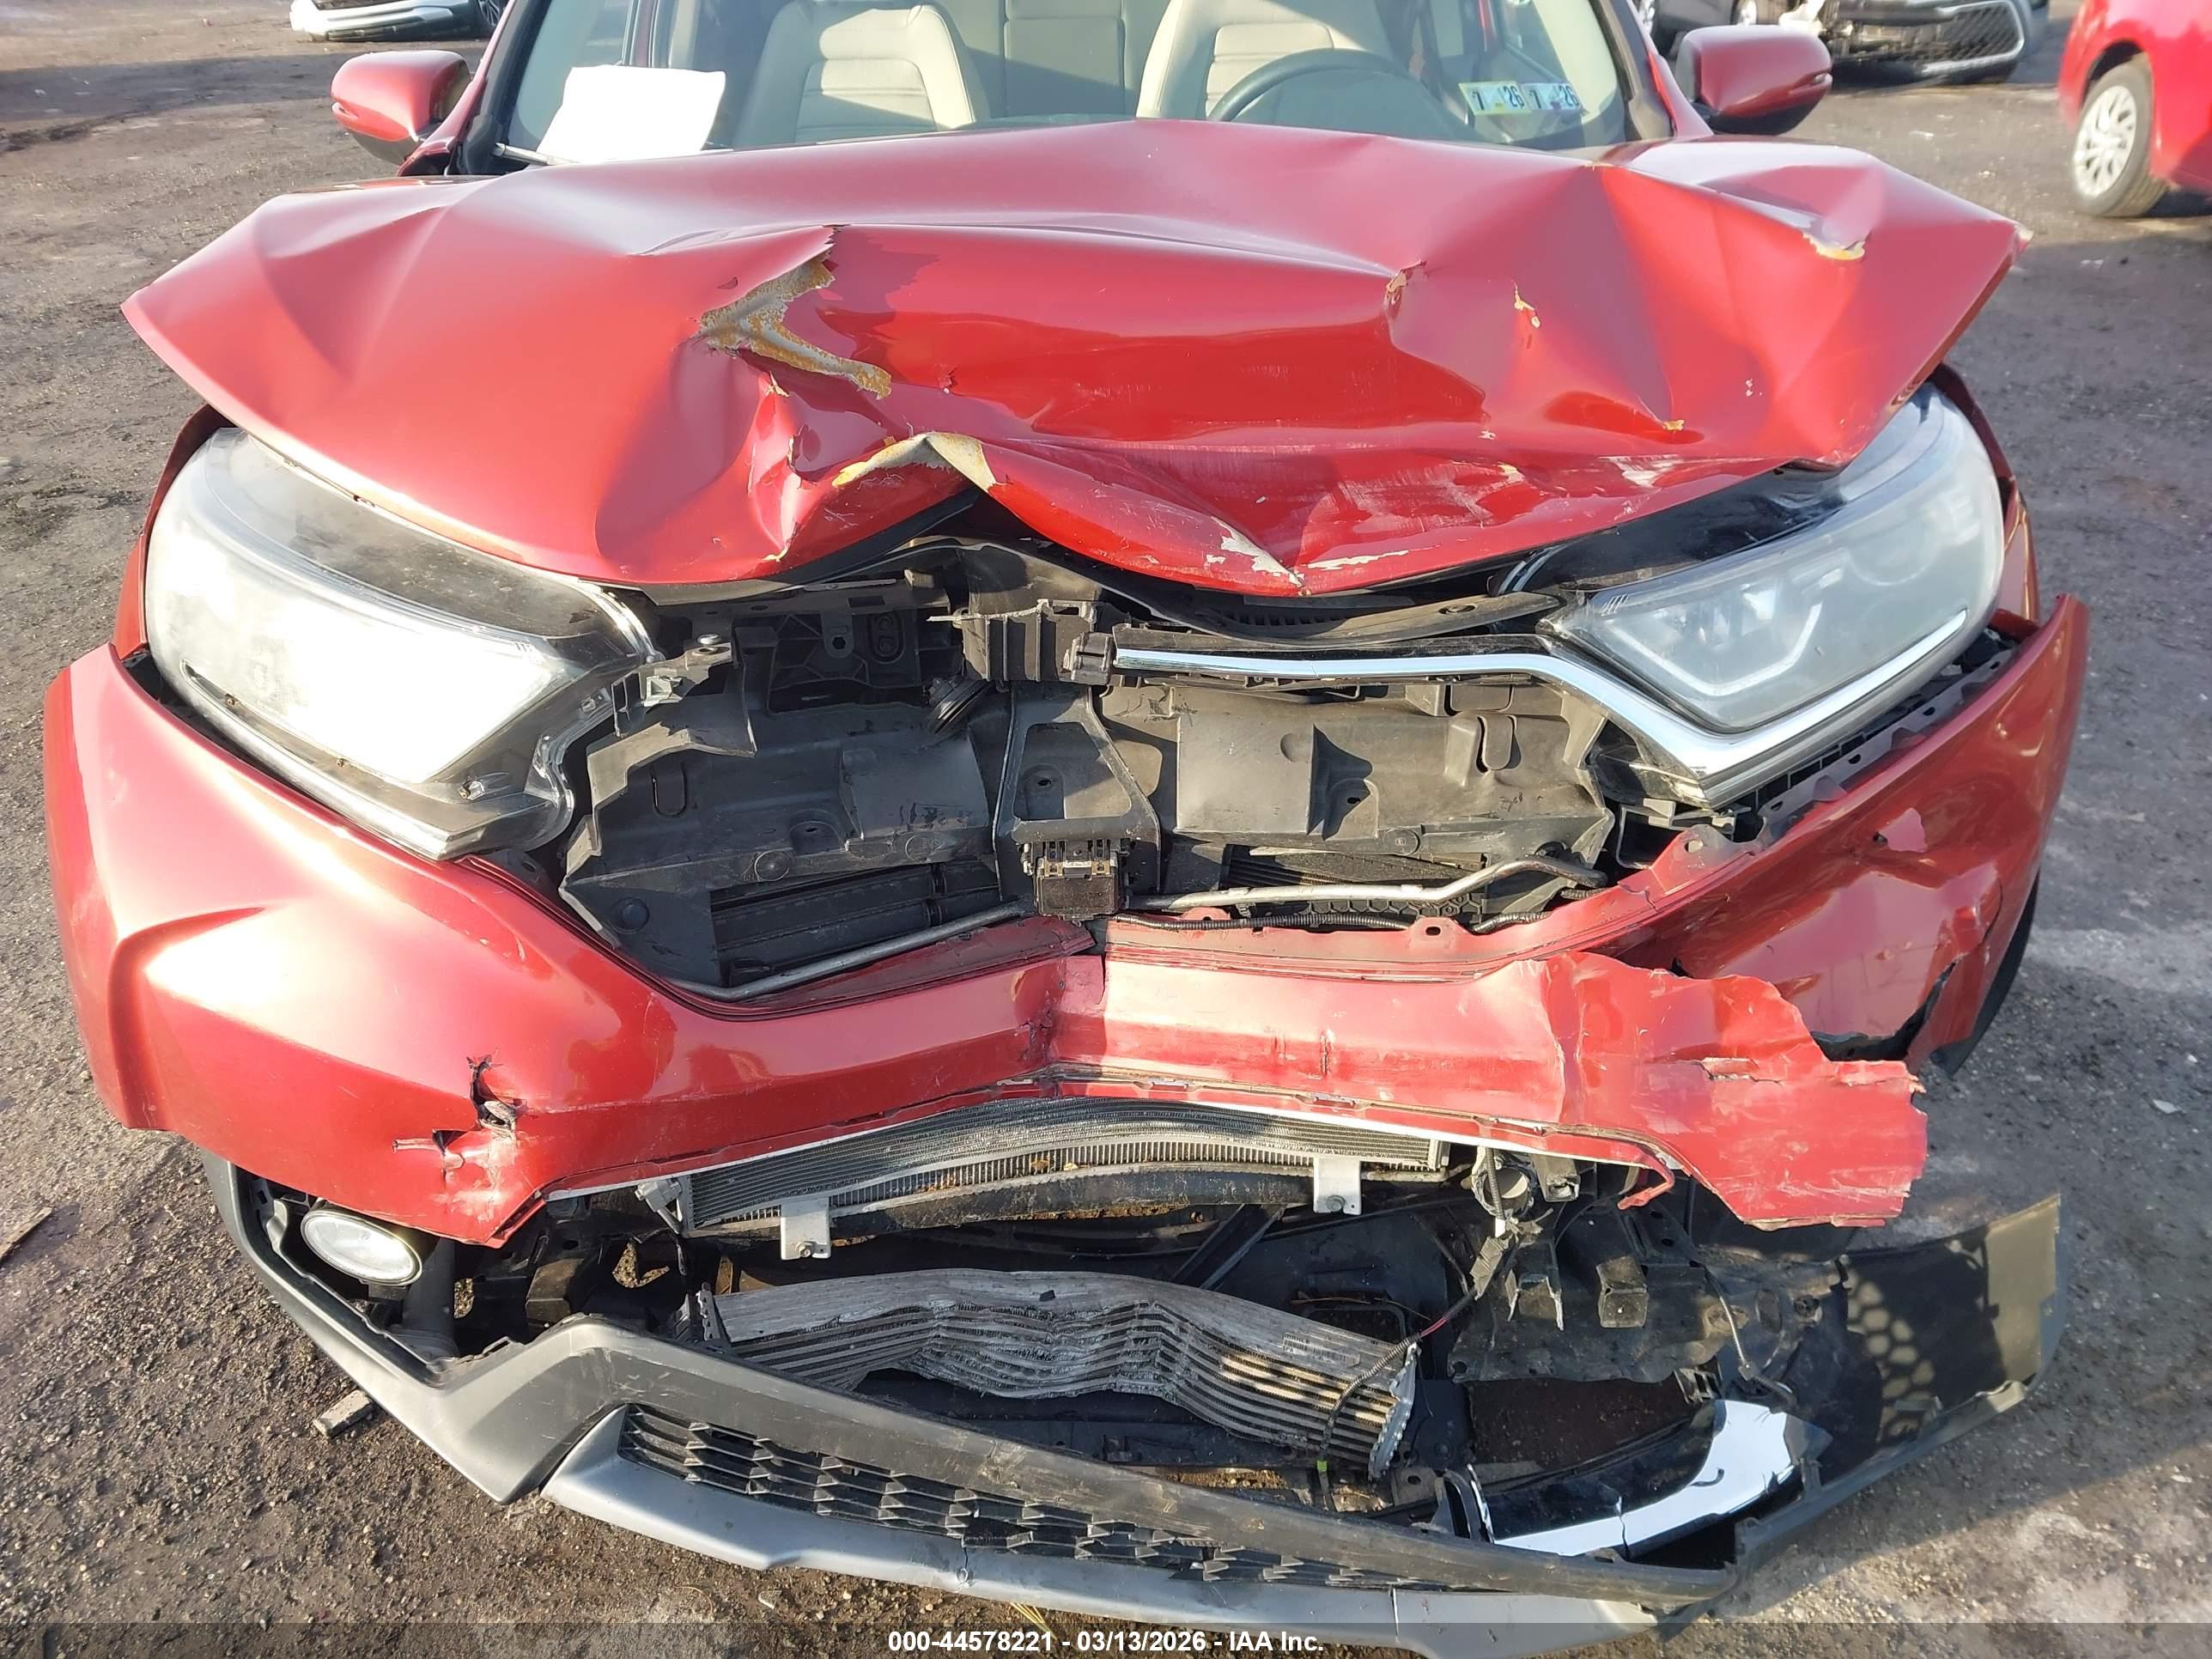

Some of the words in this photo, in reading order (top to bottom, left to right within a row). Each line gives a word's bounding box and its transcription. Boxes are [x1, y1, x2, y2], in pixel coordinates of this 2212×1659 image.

[1472, 91, 1484, 111] 7
[1503, 85, 1524, 107] 26
[1528, 90, 1542, 109] 7
[1559, 85, 1579, 106] 26
